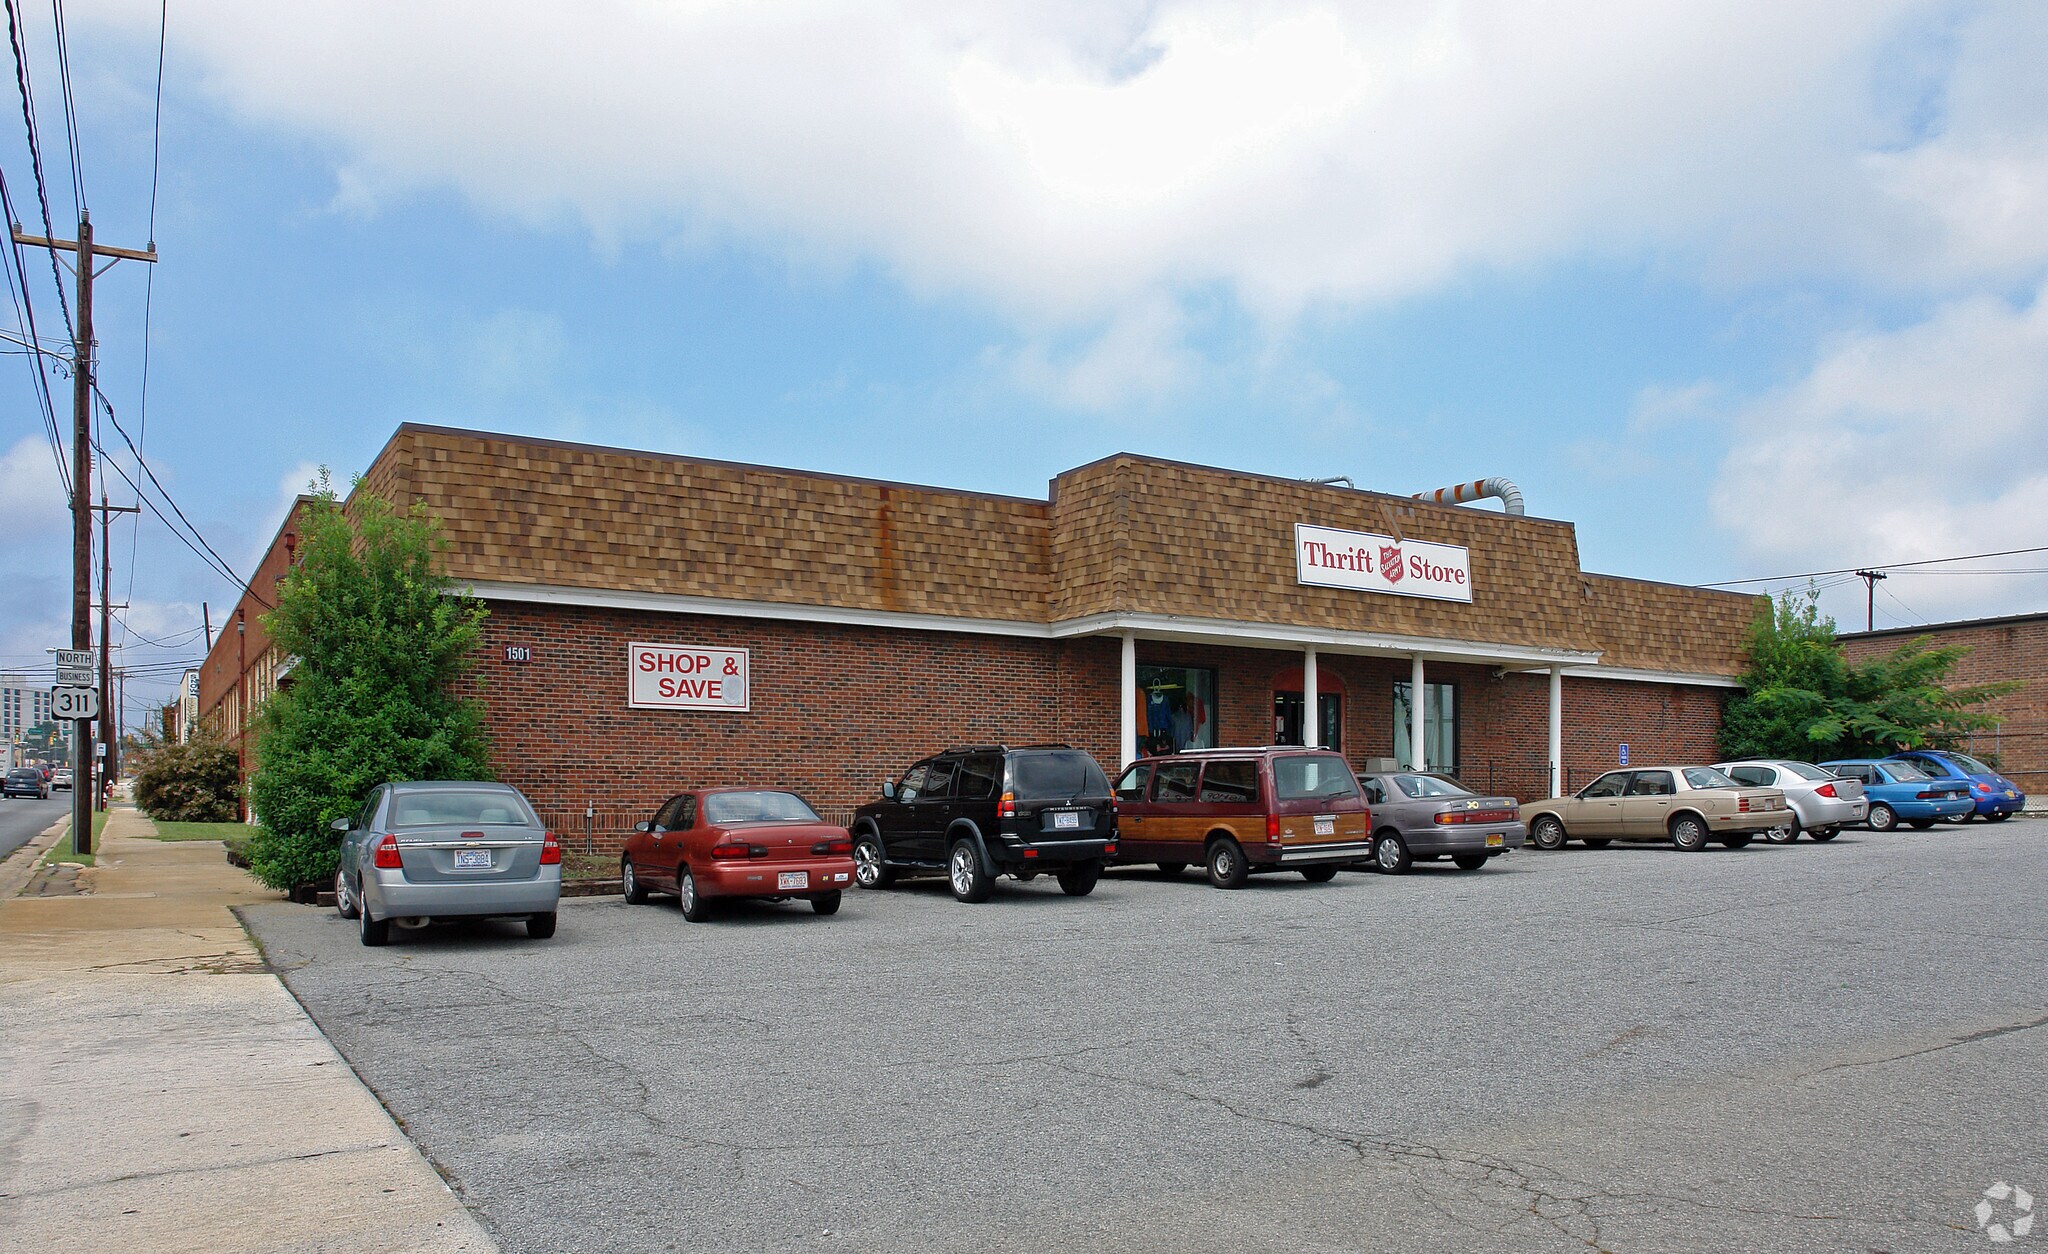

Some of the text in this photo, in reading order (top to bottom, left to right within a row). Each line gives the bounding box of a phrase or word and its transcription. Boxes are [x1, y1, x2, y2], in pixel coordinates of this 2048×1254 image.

[1304, 541, 1374, 574] Thrift
[1389, 563, 1402, 579] ARMY
[1410, 555, 1466, 584] Store
[58, 652, 92, 665] NORTH
[506, 646, 530, 661] 1501
[639, 652, 739, 676] SHOP &
[59, 671, 91, 683] BUSINESS
[658, 677, 723, 699] SAVE
[60, 693, 88, 712] 311
